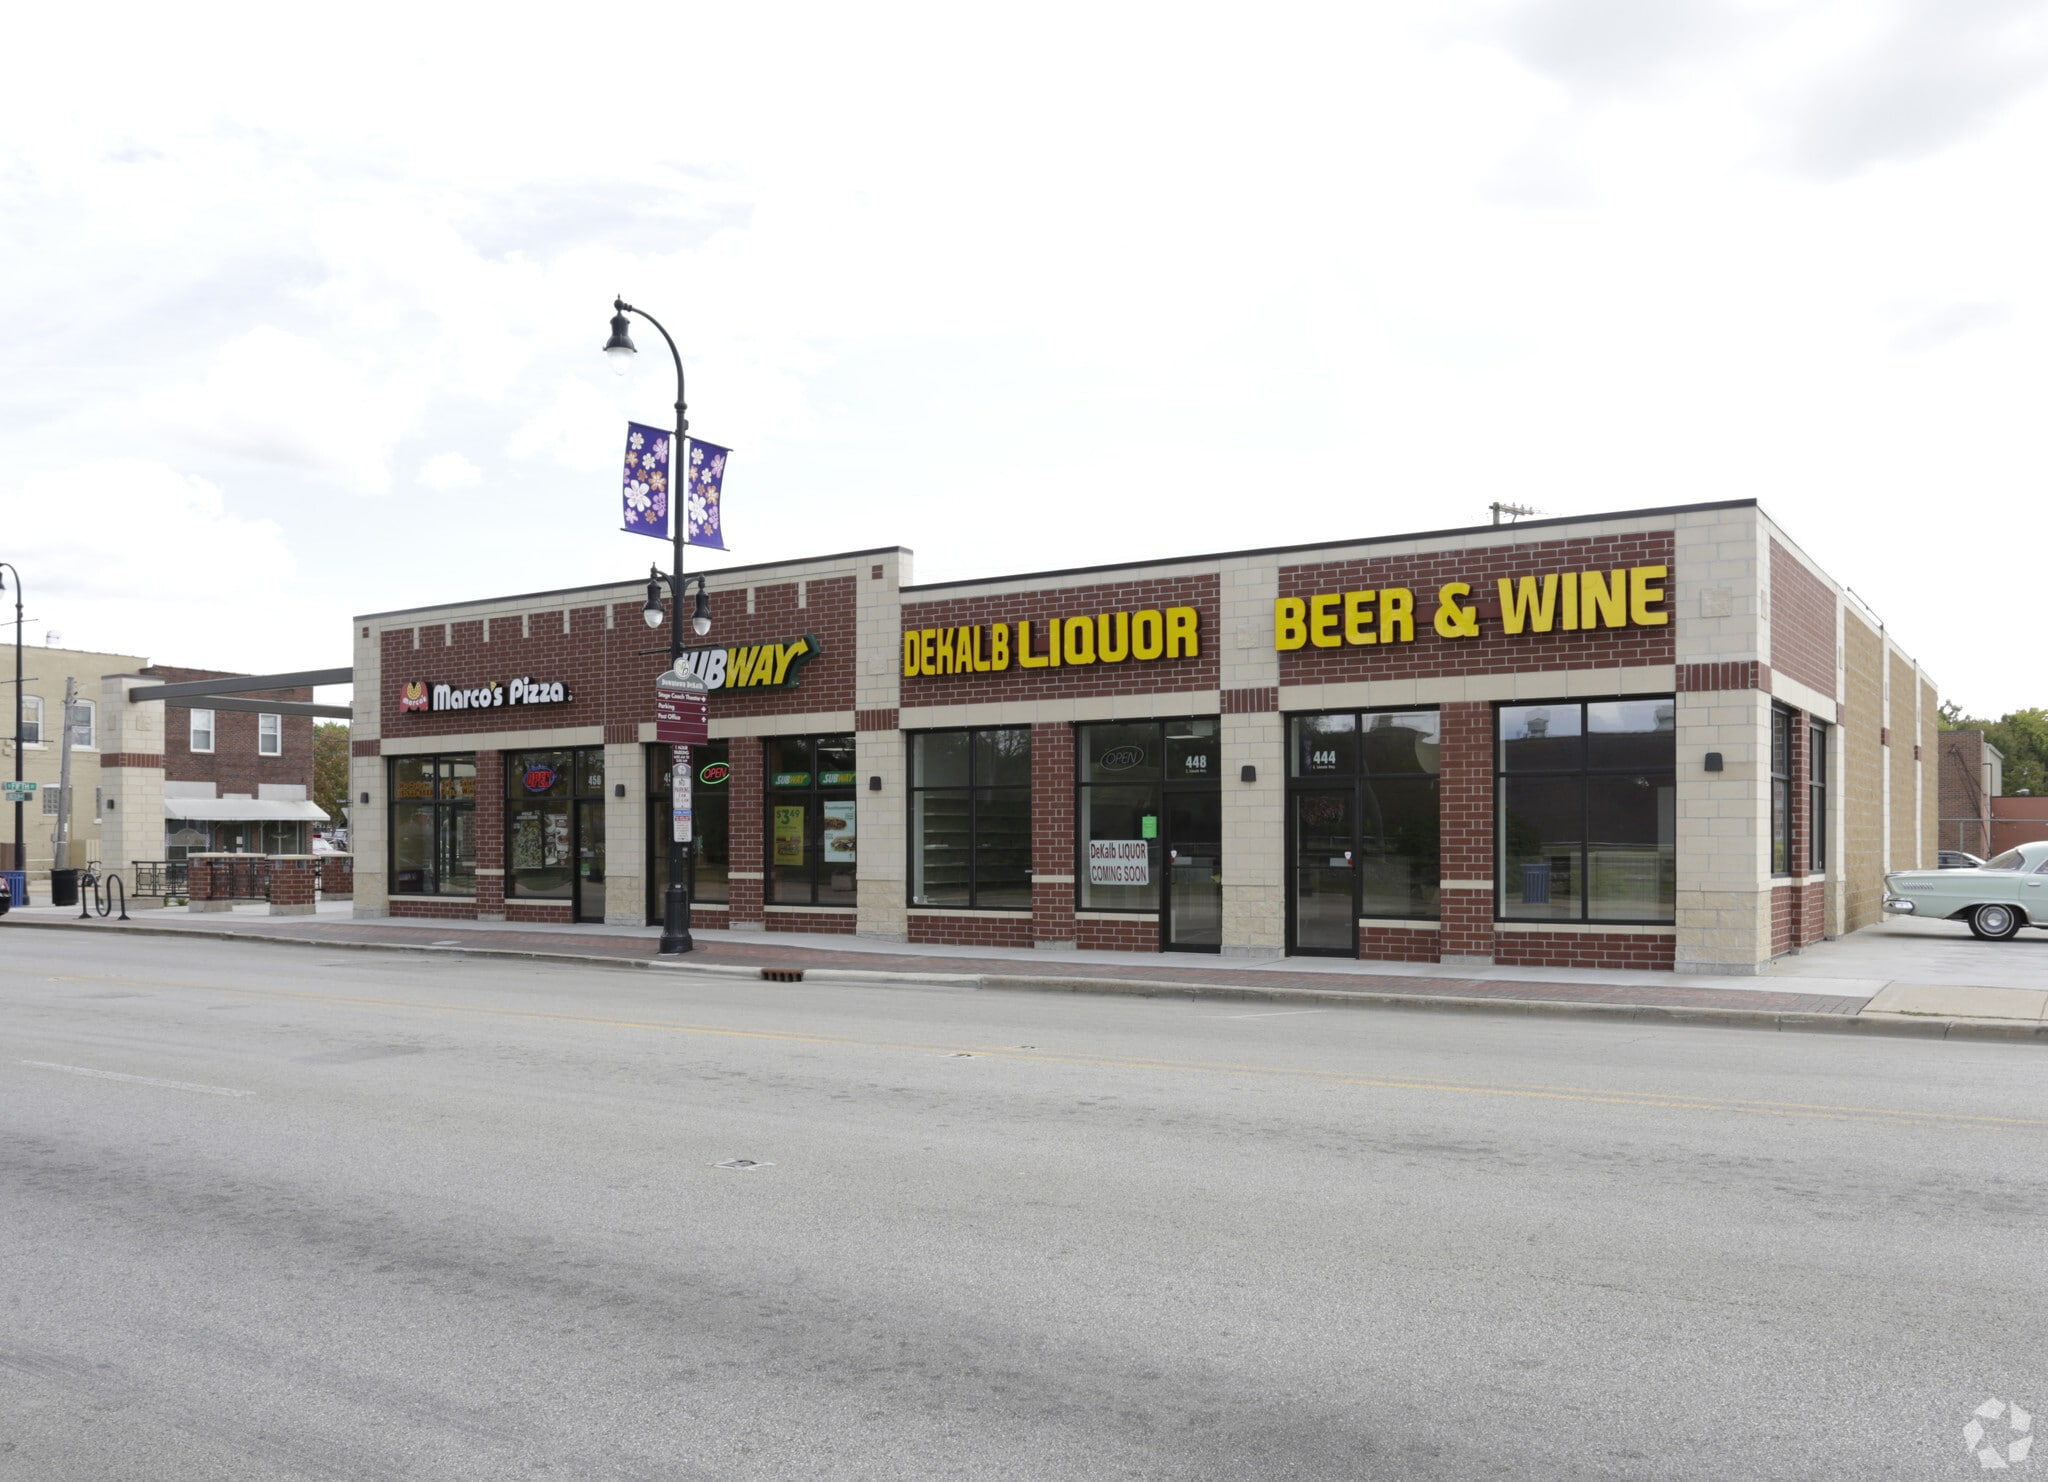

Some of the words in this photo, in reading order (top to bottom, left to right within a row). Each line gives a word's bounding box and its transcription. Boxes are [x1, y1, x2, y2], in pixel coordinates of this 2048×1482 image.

[1274, 587, 1415, 651] BEER
[1433, 582, 1480, 638] &
[1497, 564, 1669, 635] WINE
[904, 622, 1009, 677] DEKALB
[1018, 606, 1198, 669] LIQUOR
[682, 638, 808, 690] UBWAY
[433, 682, 502, 711] Marco's
[509, 676, 564, 705] Pizza
[658, 702, 675, 712] Parking
[1105, 751, 1138, 765] OPEN
[1185, 755, 1207, 768] 448
[1313, 750, 1336, 764] 444
[526, 771, 552, 788] OPEN
[704, 767, 726, 779] OPEN
[775, 774, 808, 785] SUBWAY
[822, 772, 857, 784] SUBWAY
[588, 775, 602, 786] 456
[1090, 843, 1117, 859] DeKalb
[1118, 843, 1146, 859] LIQUOR
[1091, 866, 1122, 881] COMING
[1124, 866, 1147, 881] SOON
